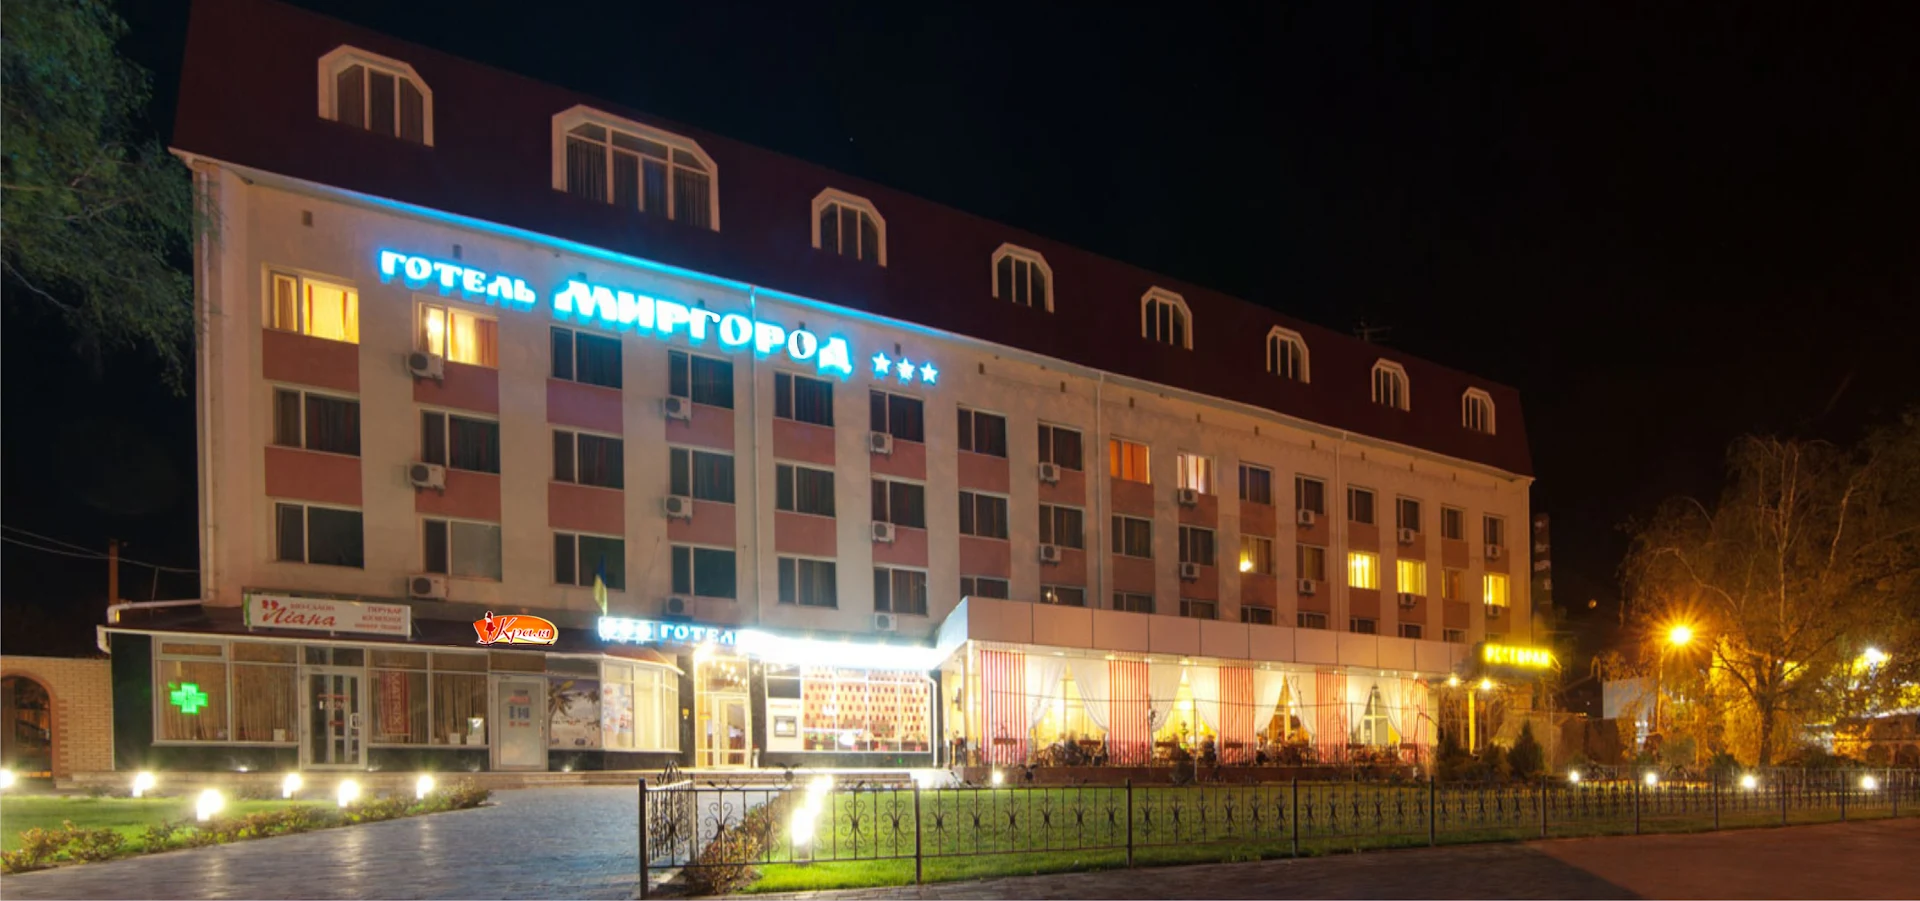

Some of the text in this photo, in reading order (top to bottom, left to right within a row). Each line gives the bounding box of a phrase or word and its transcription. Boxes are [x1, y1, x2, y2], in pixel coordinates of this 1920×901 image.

[380, 249, 852, 376] ГОТЕЛЬ МИРГОРОД
[493, 617, 551, 644] Краля
[660, 623, 741, 645] ГОТЕЛ
